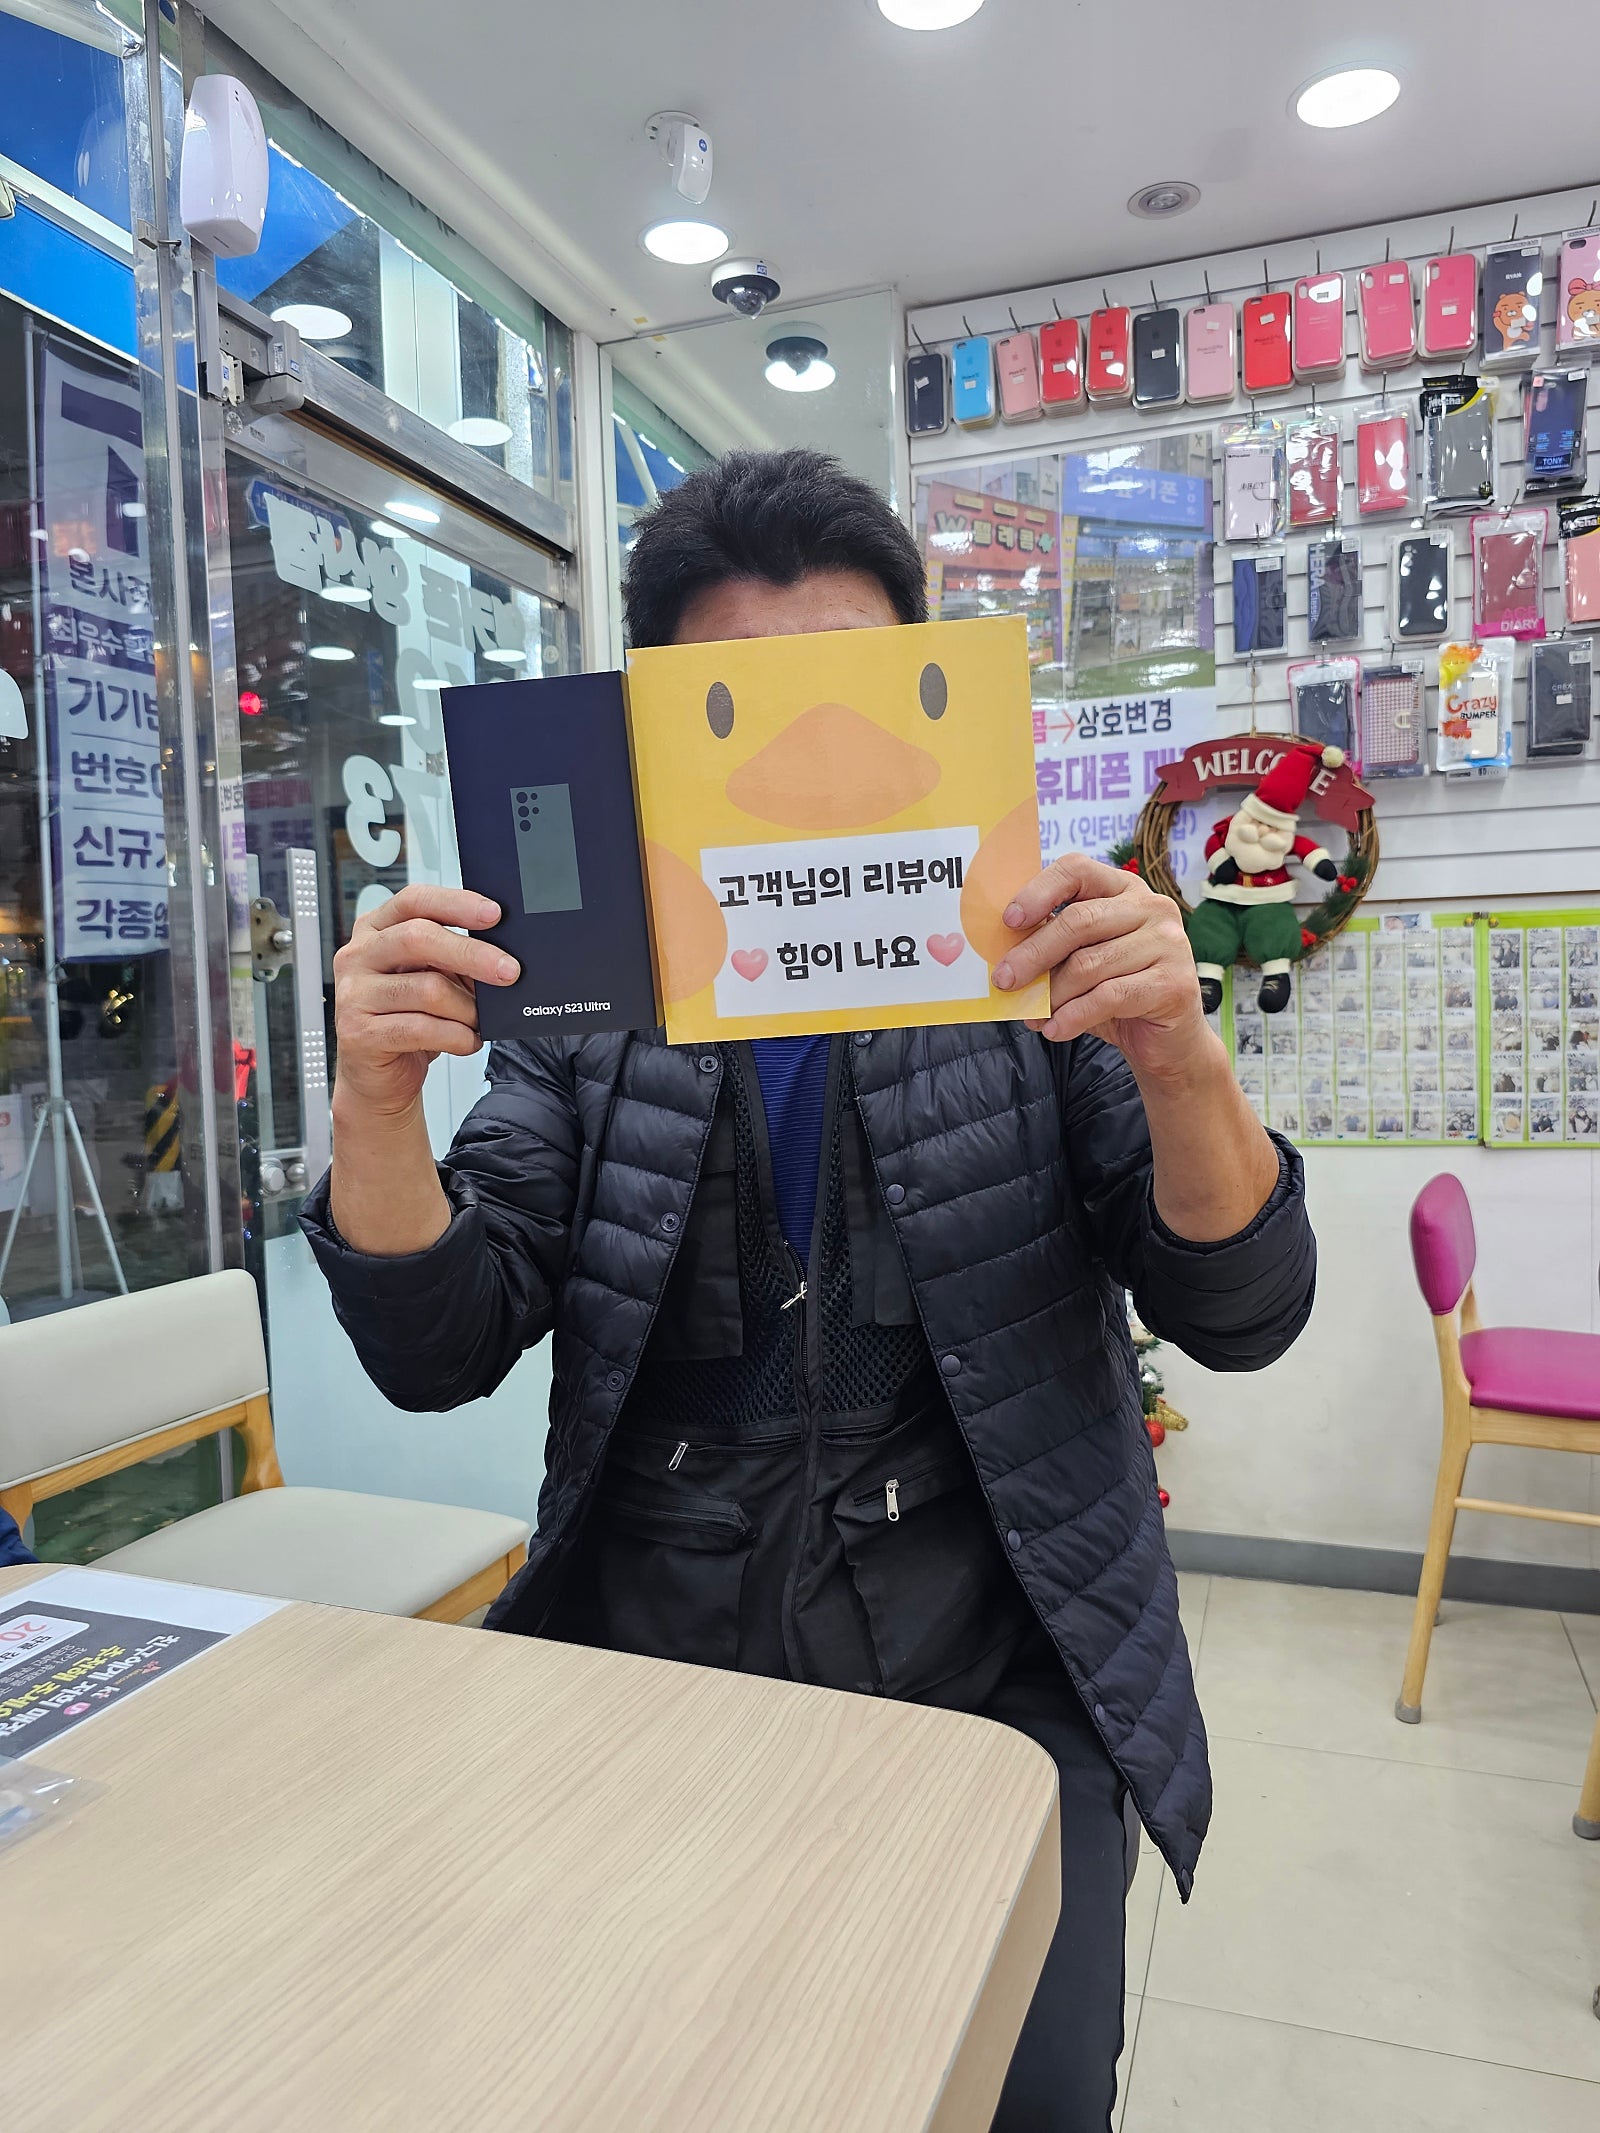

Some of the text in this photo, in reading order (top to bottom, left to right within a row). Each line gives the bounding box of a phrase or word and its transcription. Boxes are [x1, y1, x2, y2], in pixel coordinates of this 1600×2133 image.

[1542, 457, 1564, 466] TONY
[1310, 544, 1326, 590] HERA
[1501, 618, 1539, 632] DIARY
[1076, 698, 1172, 740] 상호변경
[1446, 694, 1497, 713] Crazy
[1460, 710, 1497, 720] BUMPER
[1035, 747, 1187, 805] 휴대폰 매
[1192, 748, 1337, 796] WELCE
[718, 857, 964, 908] 고객님의 리뷰에
[777, 935, 920, 981] 힘이 나요
[523, 1001, 611, 1017] Galaxy S23 Ultra
[52, 1645, 126, 1682] 추천해
[87, 1635, 181, 1681] 친구에게
[39, 1680, 98, 1709] 저희
[91, 1685, 121, 1700] kt
